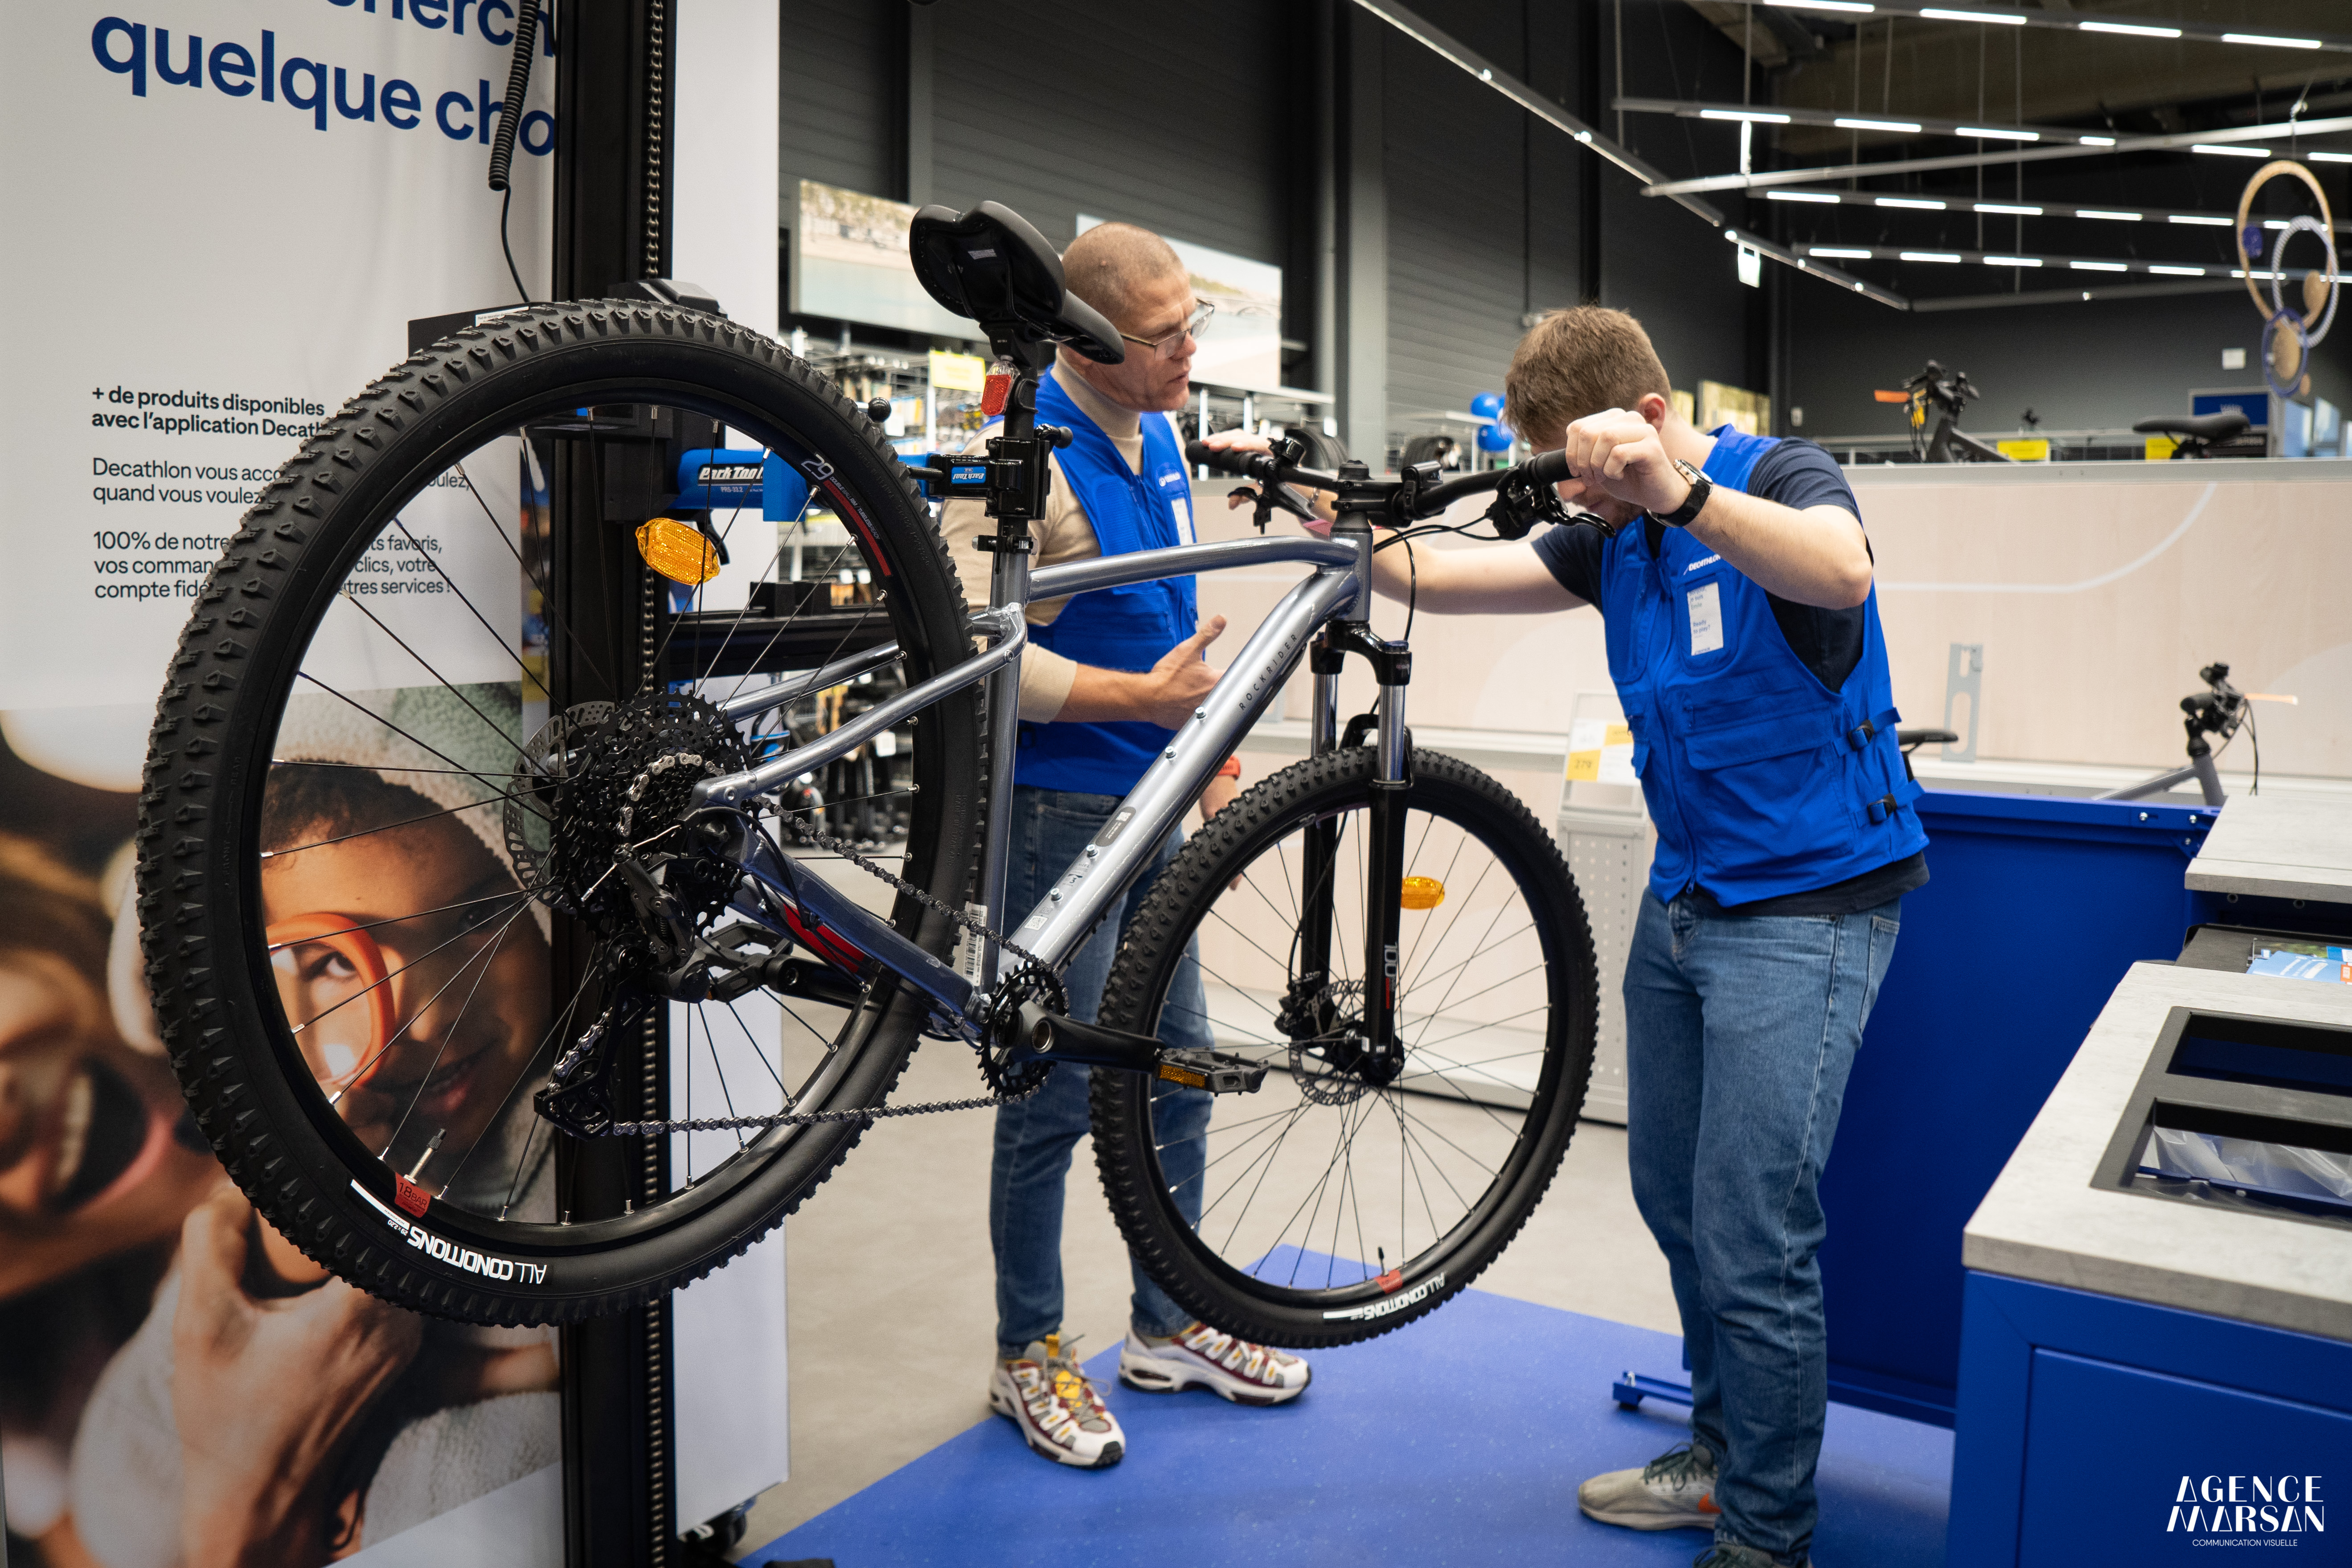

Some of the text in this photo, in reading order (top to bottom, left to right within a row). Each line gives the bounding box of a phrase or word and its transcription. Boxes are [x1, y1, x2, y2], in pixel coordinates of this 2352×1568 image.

[91, 16, 421, 131] quelque
[93, 386, 325, 416] + de produits disponibles
[92, 413, 139, 428] avec
[143, 411, 258, 435] l'application
[93, 458, 191, 479] Decathlon
[195, 466, 238, 480] vous
[699, 466, 764, 480] Park Tool
[801, 452, 834, 480] 29
[93, 484, 154, 504] quand
[159, 489, 202, 503] vous
[829, 476, 844, 491] DOUBLE
[849, 498, 858, 507] RIM
[857, 507, 873, 528] TUBELESS
[869, 524, 881, 540] READY
[94, 532, 151, 550] 100%
[155, 532, 178, 549] de
[387, 535, 443, 554] favoris,
[94, 560, 128, 573] vos
[355, 557, 394, 575] clics,
[397, 557, 436, 573] votre
[94, 581, 170, 602] compte
[381, 578, 444, 594] services
[1239, 634, 1297, 710] ROCKRIDER
[406, 1226, 547, 1284] ALL CONDITIONS
[1364, 1272, 1446, 1321] ALL CONDITIONS
